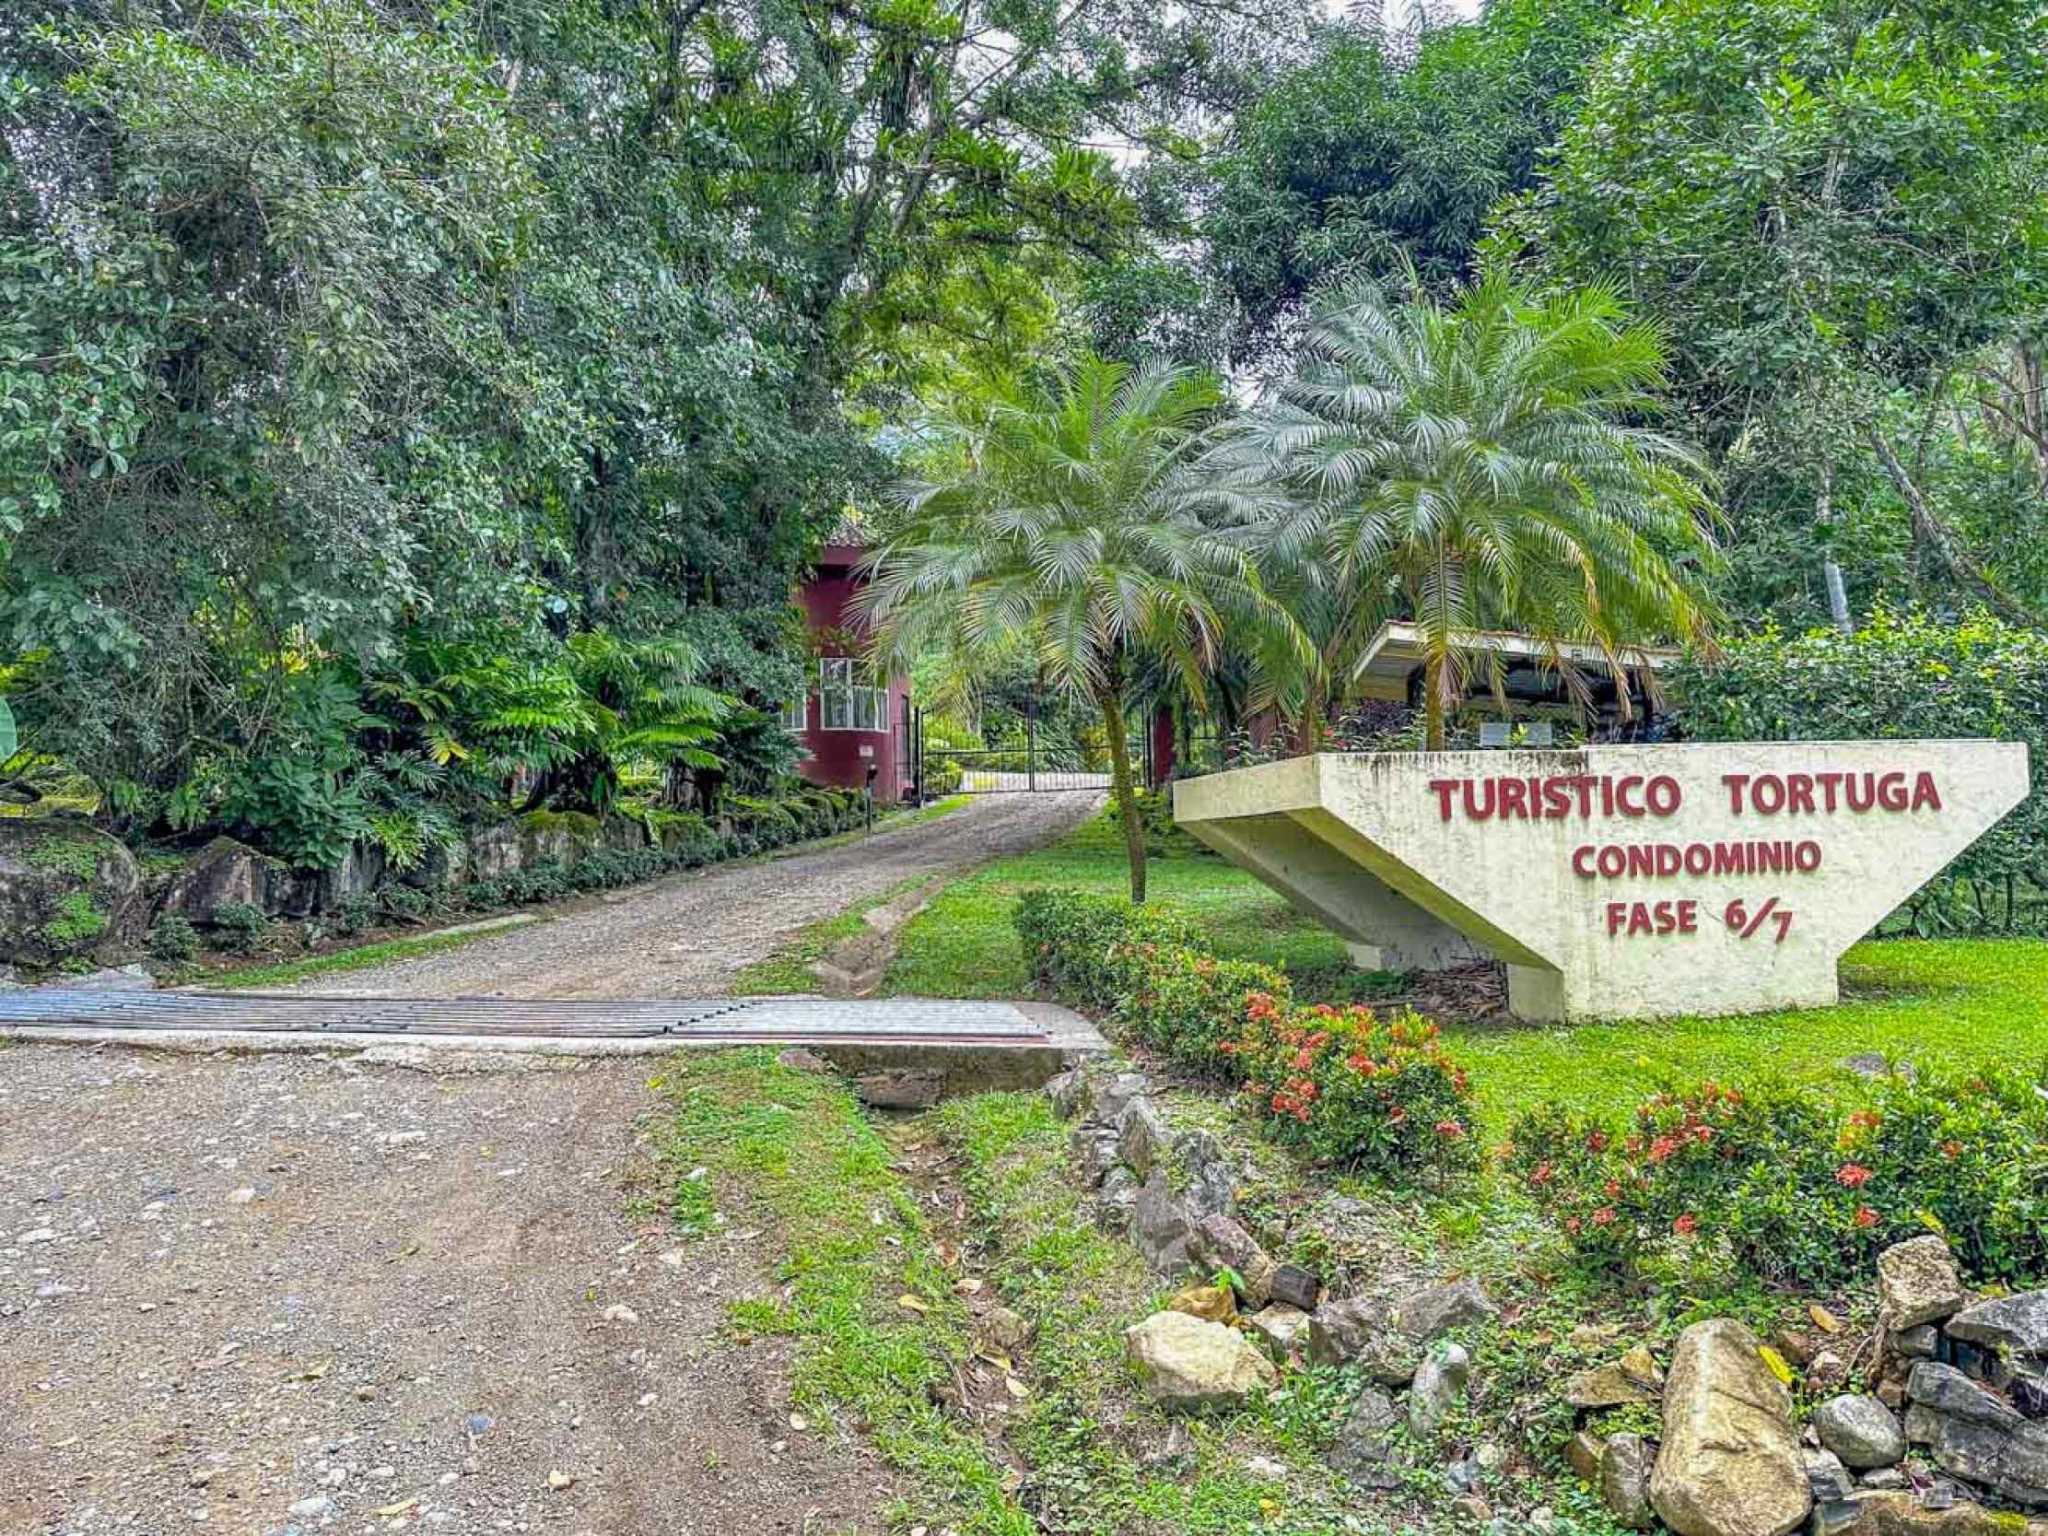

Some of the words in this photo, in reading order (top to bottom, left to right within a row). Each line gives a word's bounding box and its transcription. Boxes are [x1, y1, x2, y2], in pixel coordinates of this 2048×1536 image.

[1430, 774, 1682, 820] TURISTICO
[1722, 772, 1941, 814] TORTUGA
[1572, 840, 1821, 877] CONDOMINIO
[1607, 900, 1698, 935] FASE
[1725, 898, 1793, 942] 6/7
